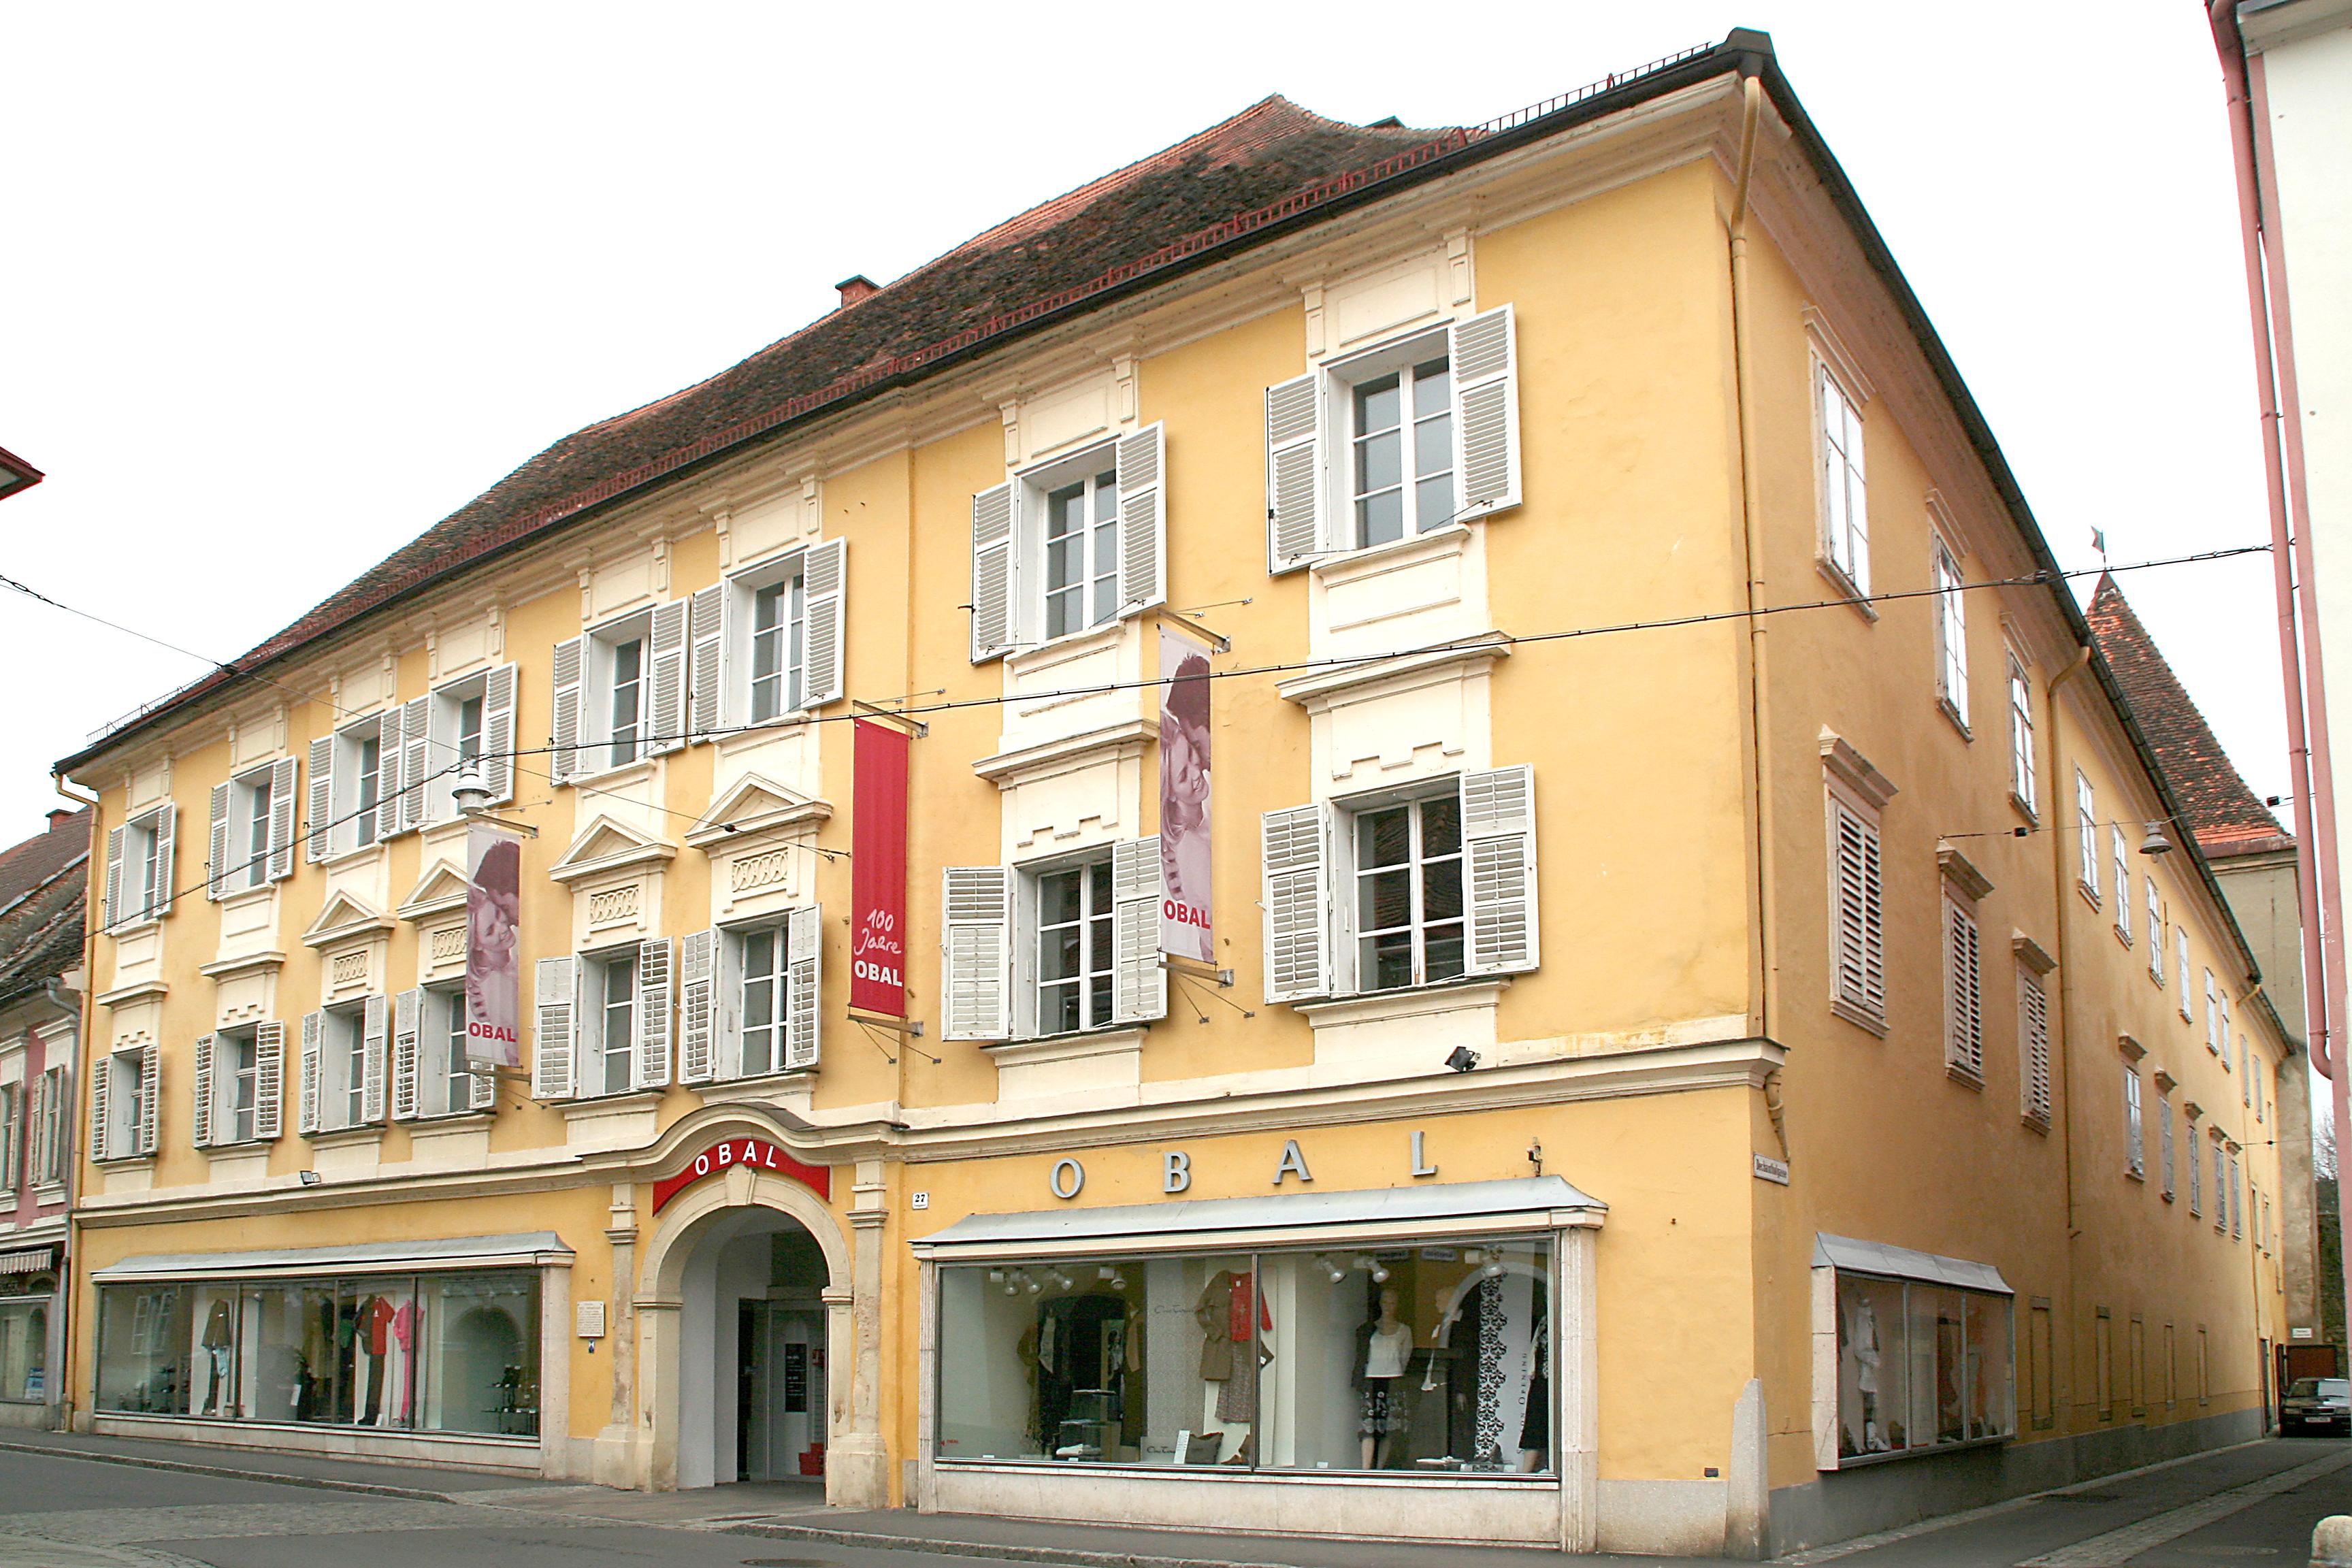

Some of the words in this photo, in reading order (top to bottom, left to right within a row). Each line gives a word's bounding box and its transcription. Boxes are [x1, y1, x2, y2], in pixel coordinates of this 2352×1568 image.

[866, 909, 894, 932] 100
[1163, 900, 1211, 930] OBAL
[853, 928, 902, 956] Jahre
[854, 960, 903, 987] OBAL
[469, 1022, 517, 1043] OBAL
[695, 1141, 777, 1175] OBAL
[1049, 1130, 1438, 1199] OBAL
[915, 1194, 926, 1203] 27
